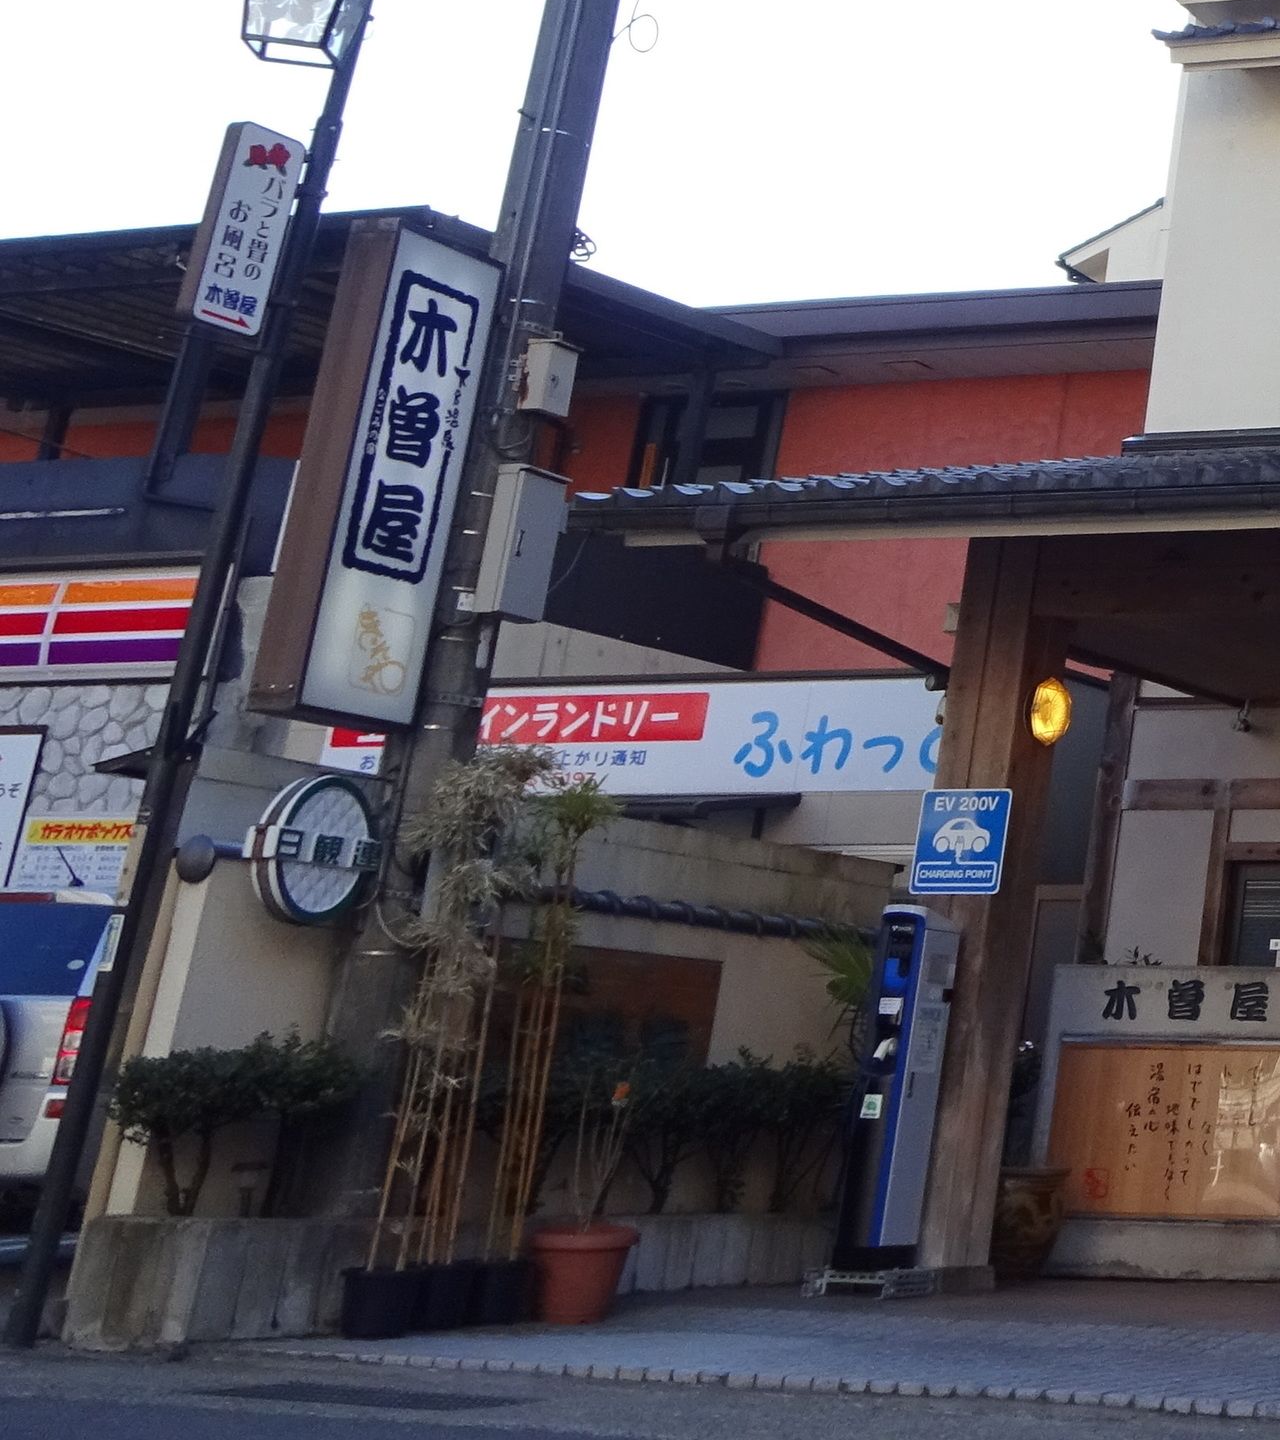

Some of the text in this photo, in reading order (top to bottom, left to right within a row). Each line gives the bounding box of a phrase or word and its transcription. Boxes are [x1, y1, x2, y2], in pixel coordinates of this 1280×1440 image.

[213, 199, 251, 278] お風呂
[244, 177, 287, 280] バラと畳の
[204, 283, 258, 317] 木曽屋
[362, 298, 457, 563] 木曽屋
[933, 796, 1000, 811] EV 200V
[41, 822, 136, 840] カラオケボックス
[919, 868, 993, 880] CHARGING POINT
[1101, 979, 1270, 1022] 木曽屋
